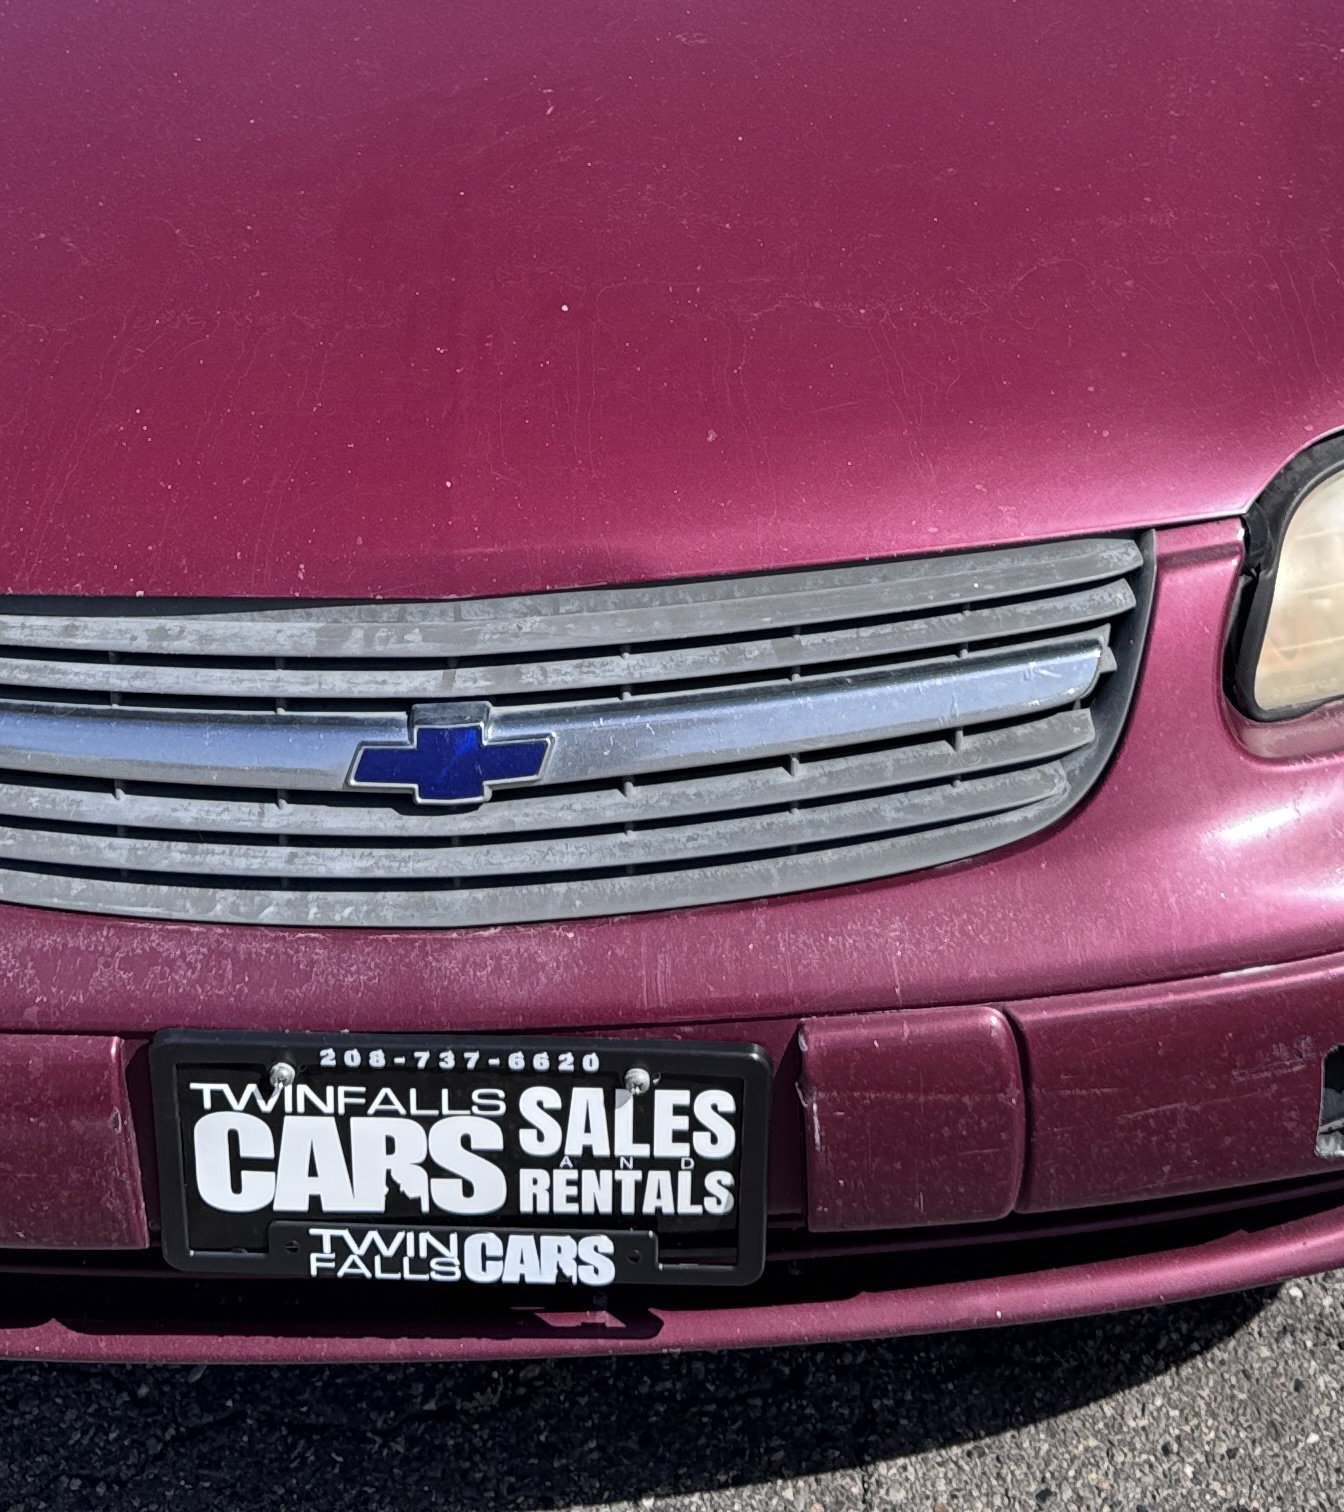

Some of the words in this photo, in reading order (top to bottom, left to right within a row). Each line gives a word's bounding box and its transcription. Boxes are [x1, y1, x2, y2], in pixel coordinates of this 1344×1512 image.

[319, 1047, 600, 1073] 208-737-6620
[519, 1086, 737, 1159] SALES
[193, 1110, 507, 1216] CARS
[519, 1168, 736, 1216] RENTALS
[308, 1227, 458, 1259] TWIN
[309, 1252, 462, 1281] FALLS
[463, 1232, 616, 1287] CARS
